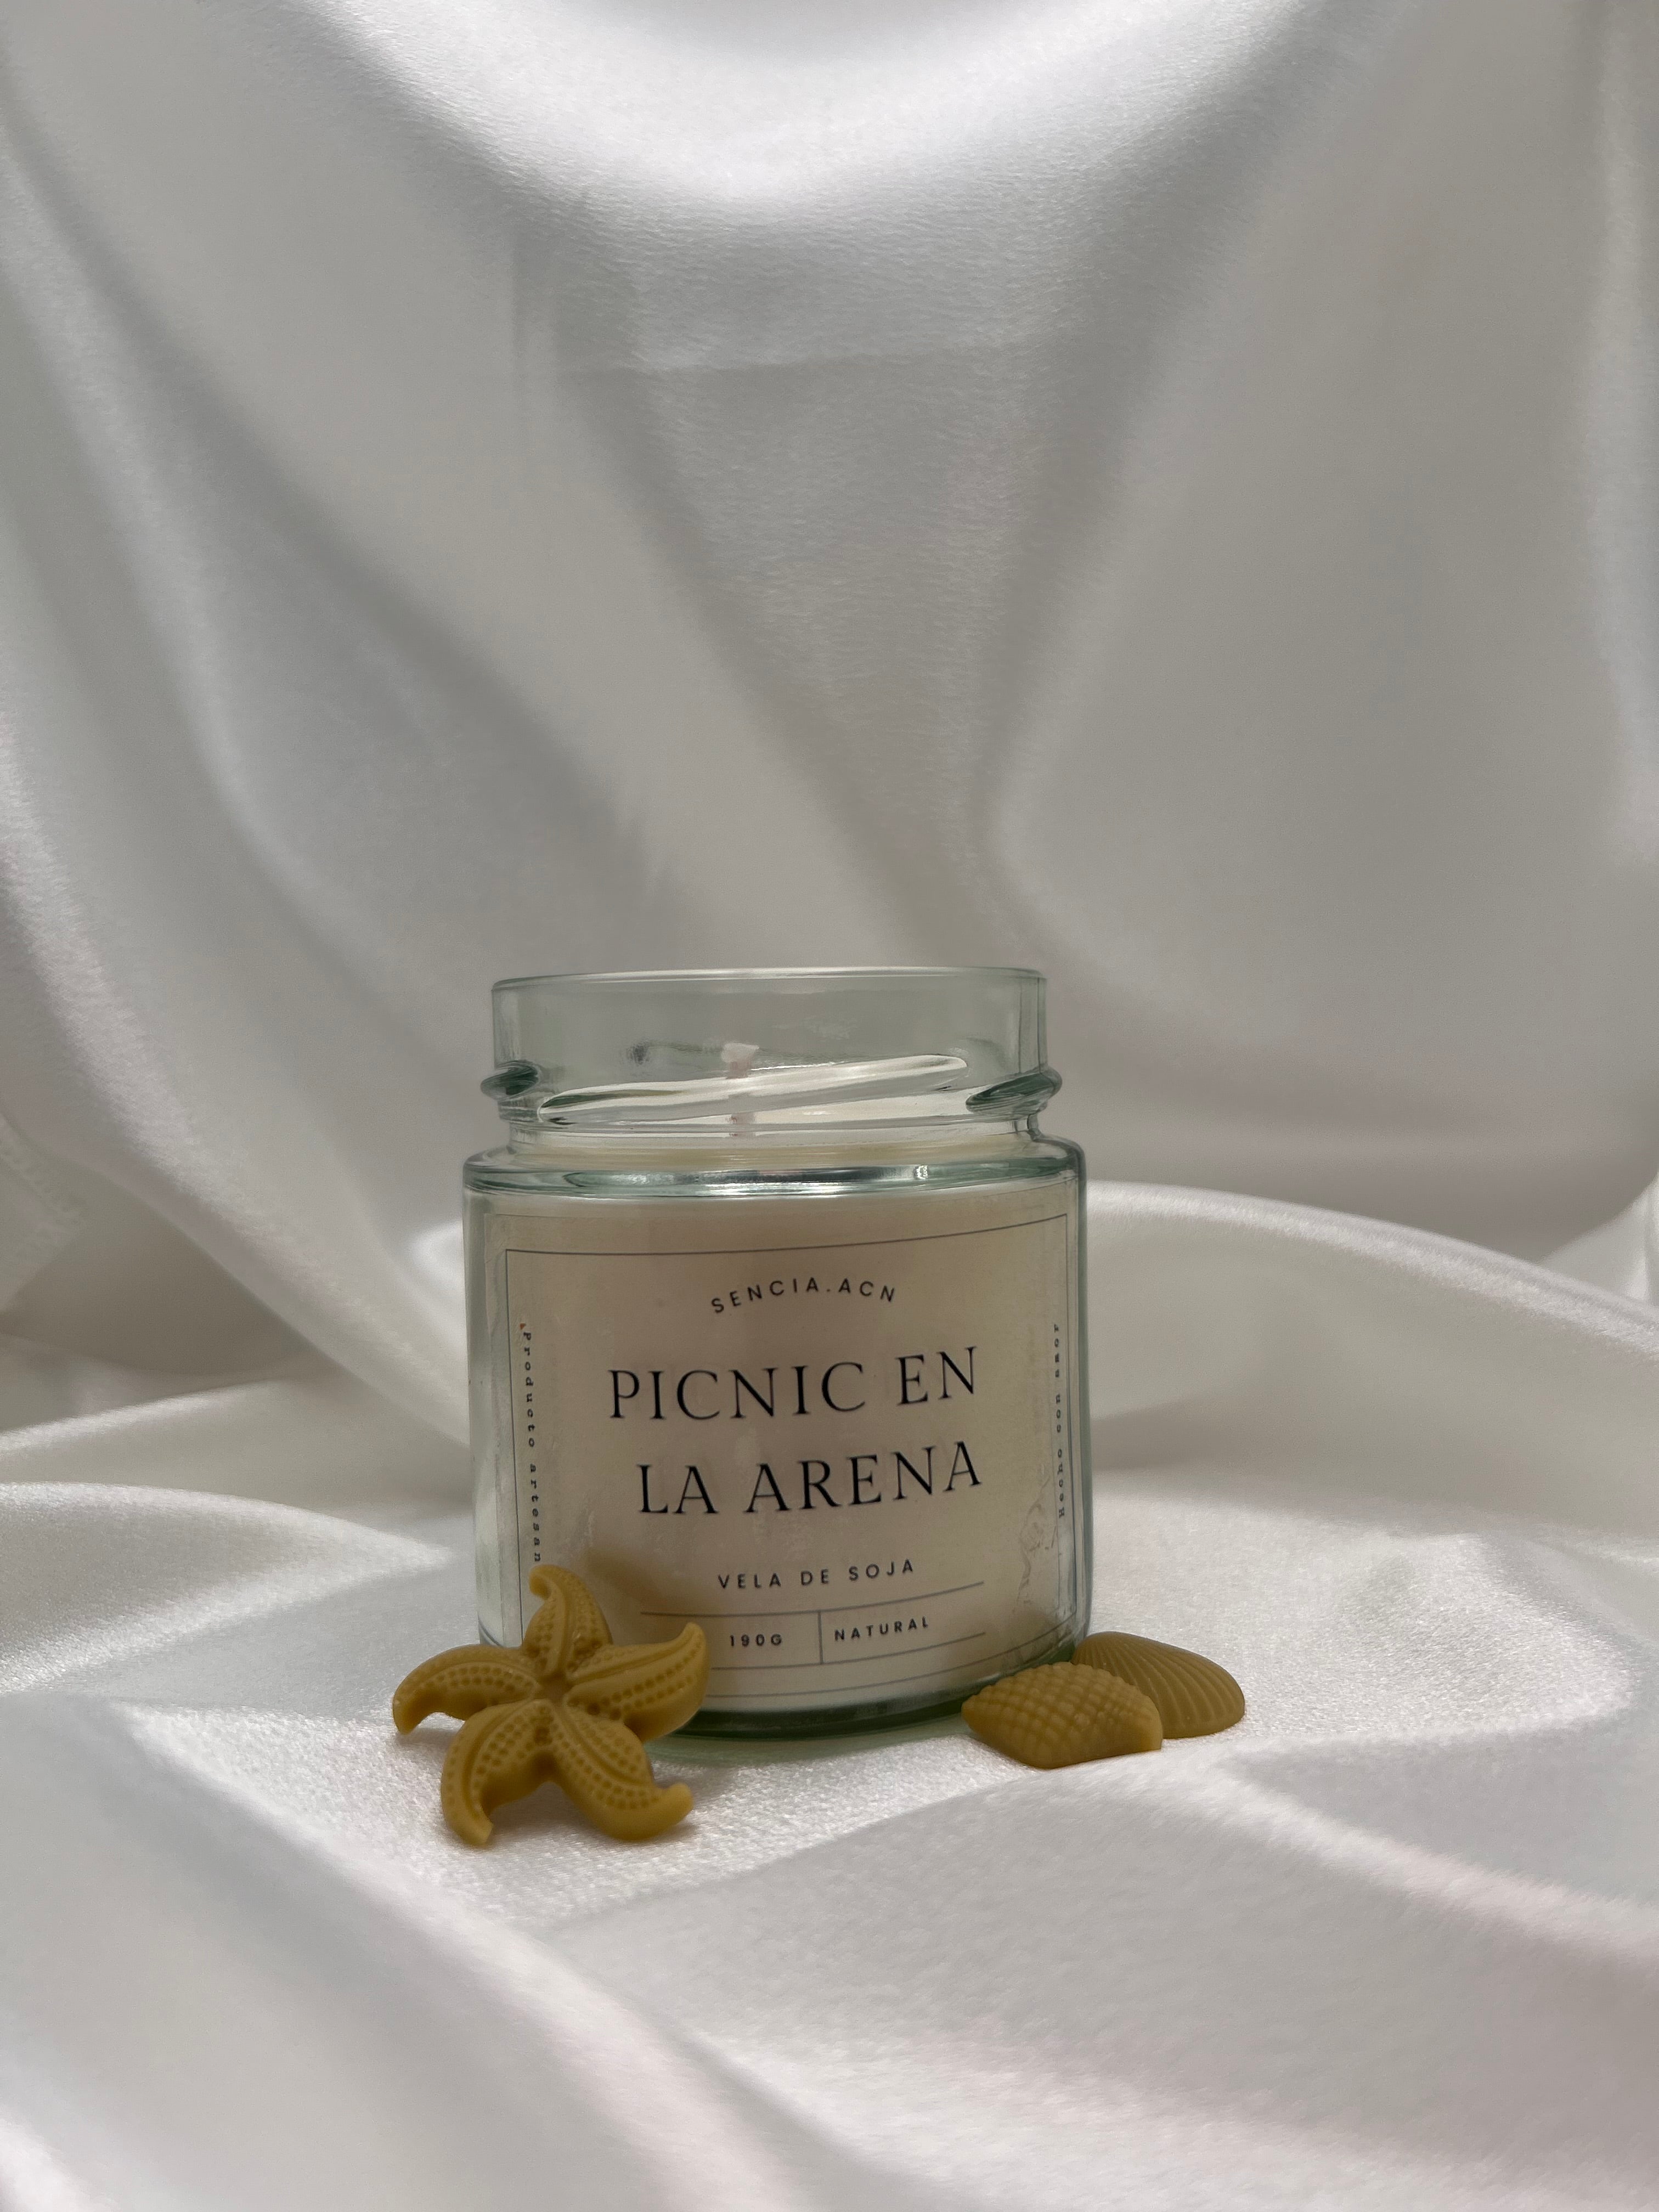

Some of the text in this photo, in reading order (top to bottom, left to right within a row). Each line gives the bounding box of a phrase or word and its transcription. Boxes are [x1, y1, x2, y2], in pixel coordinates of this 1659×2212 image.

[710, 1276, 896, 1314] SENCIA.ACN
[608, 1346, 978, 1421] PICNIC EN
[522, 1331, 542, 1563] Producto artesan
[1053, 1323, 1066, 1520] Hecho con amor
[636, 1440, 983, 1515] LA ARENA
[717, 1558, 915, 1590] VELA DE SOJA
[729, 1633, 783, 1648] 190G
[833, 1616, 929, 1643] NATURAL
